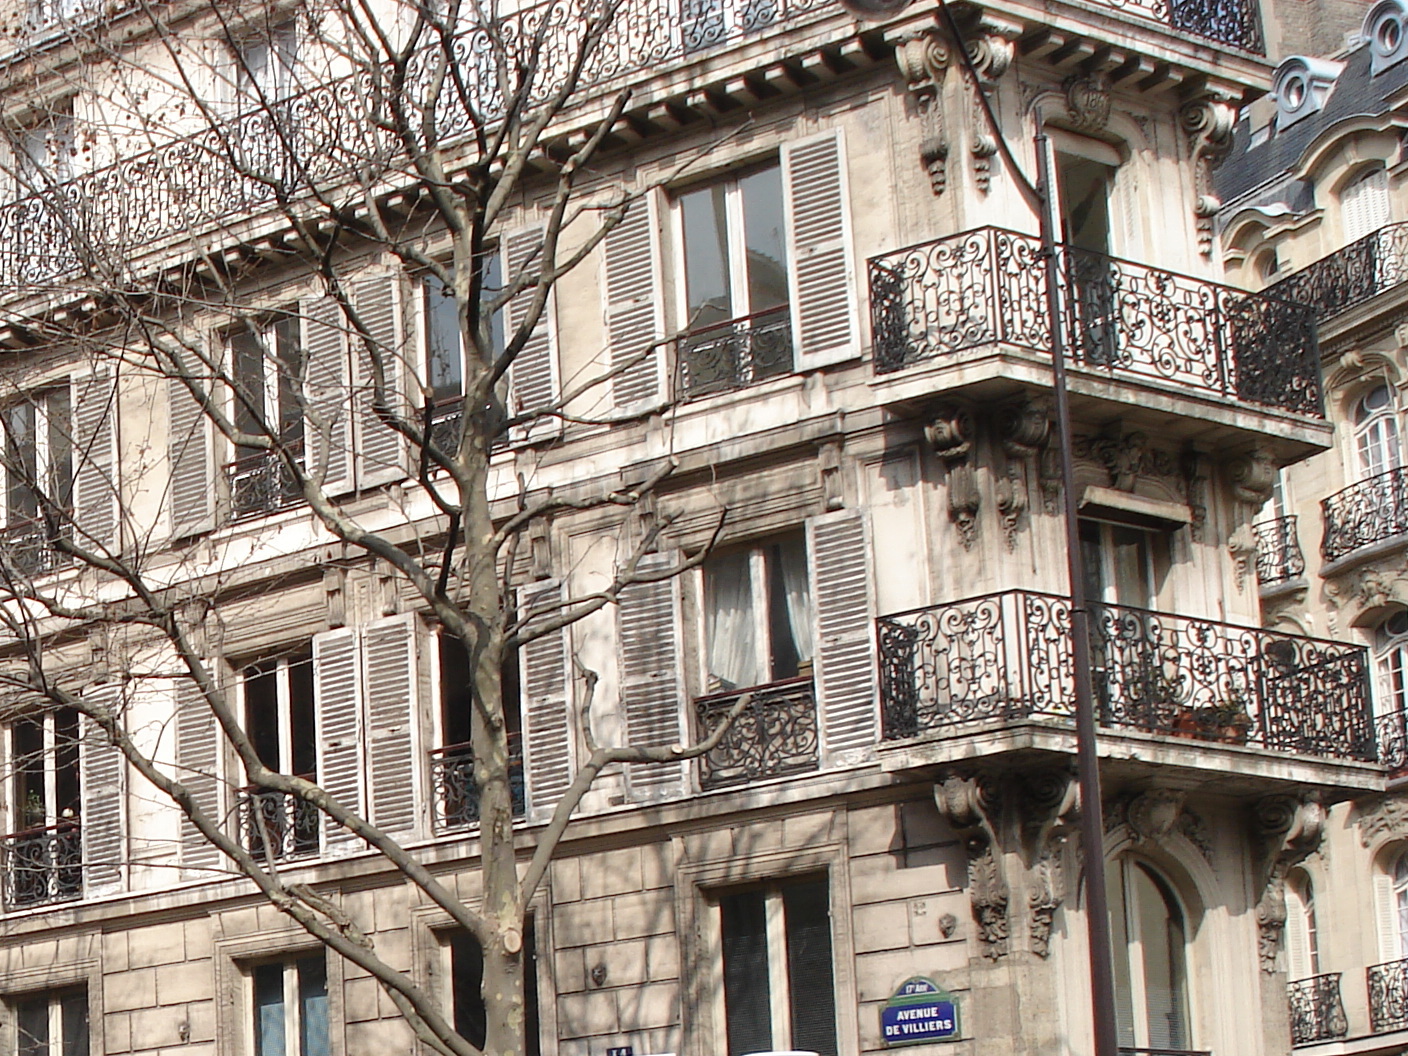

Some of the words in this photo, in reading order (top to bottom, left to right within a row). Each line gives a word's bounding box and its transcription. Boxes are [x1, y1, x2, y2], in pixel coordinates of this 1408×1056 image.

[897, 1007, 938, 1021] AVENUE
[886, 1025, 901, 1036] DE
[902, 1020, 952, 1034] VILLIERS
